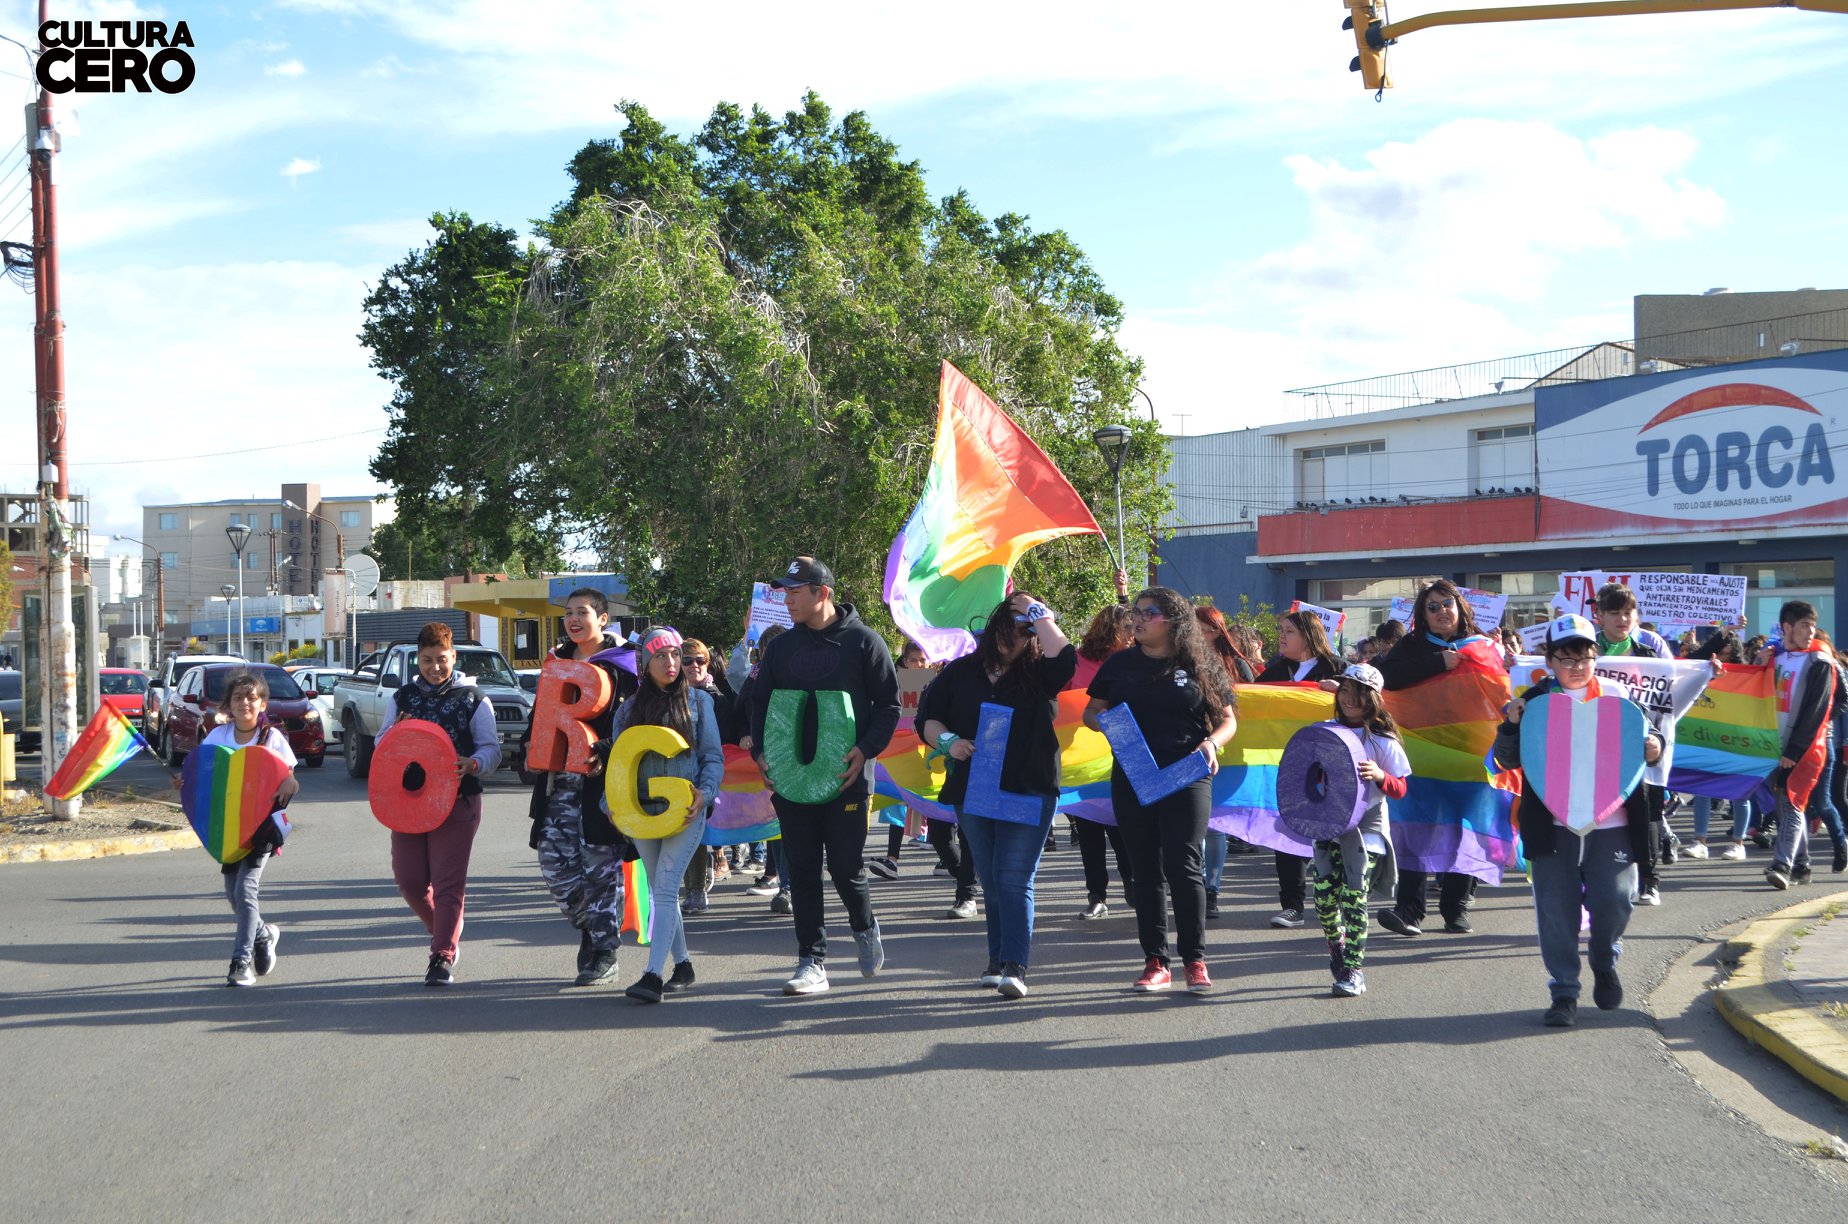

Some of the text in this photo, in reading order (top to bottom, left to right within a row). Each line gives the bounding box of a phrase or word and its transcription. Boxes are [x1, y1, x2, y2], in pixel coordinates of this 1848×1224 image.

[1635, 422, 1835, 497] TORCA
[1673, 494, 1793, 511] TODO LO QUE IMAGINAS PARA EL HOGAR
[1639, 574, 1709, 586] RESPONSABLE
[1718, 576, 1746, 589] AJUSTE
[1639, 584, 1653, 592] QUE
[1656, 584, 1672, 592] DEJA
[1323, 613, 1331, 621] la
[1645, 609, 1685, 619] NUESTRO
[1688, 611, 1733, 623] COLECTIVO
[368, 658, 1371, 840] O R G U L L O
